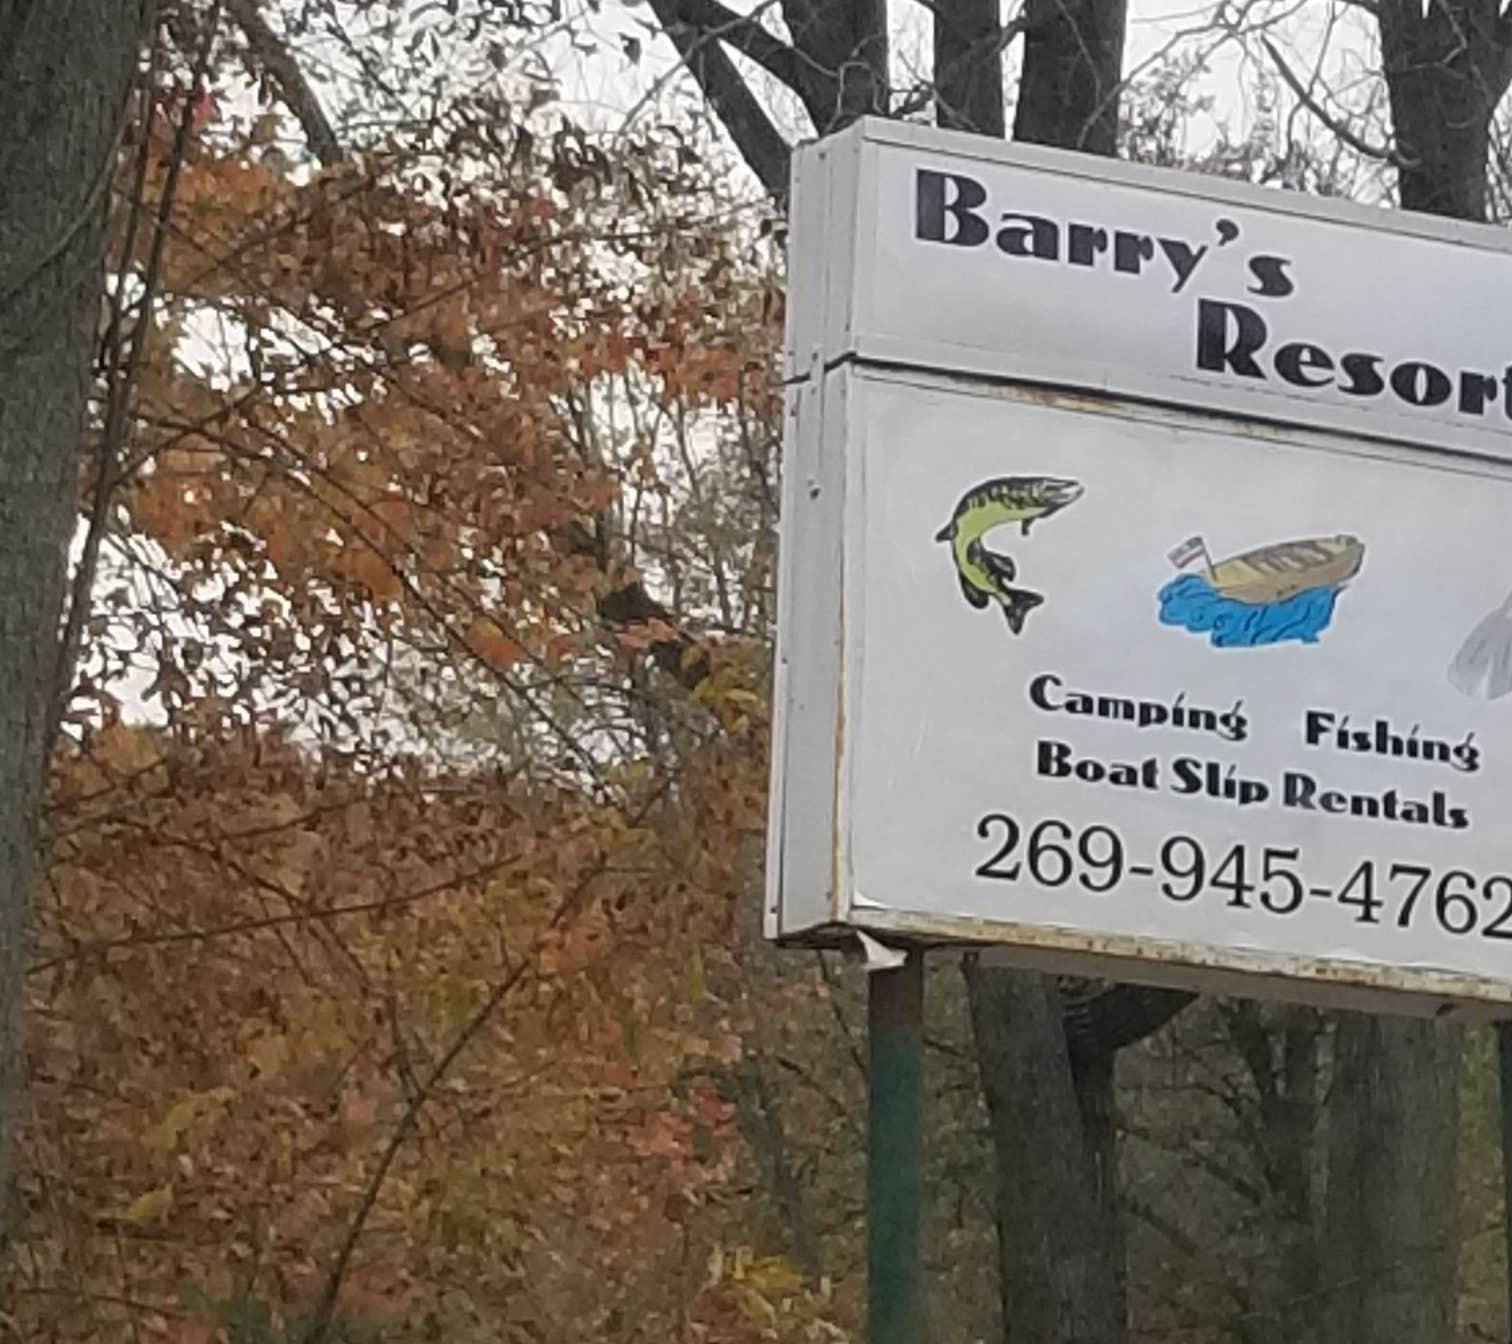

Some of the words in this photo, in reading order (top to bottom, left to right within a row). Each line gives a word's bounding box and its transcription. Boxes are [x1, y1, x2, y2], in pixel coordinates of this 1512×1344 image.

[913, 167, 1296, 299] Barry's
[1028, 673, 1248, 743] Camping
[1305, 709, 1480, 774] Fishing
[1036, 739, 1159, 791] Boat
[1170, 757, 1270, 806] Slip
[1282, 771, 1470, 830] Rentals
